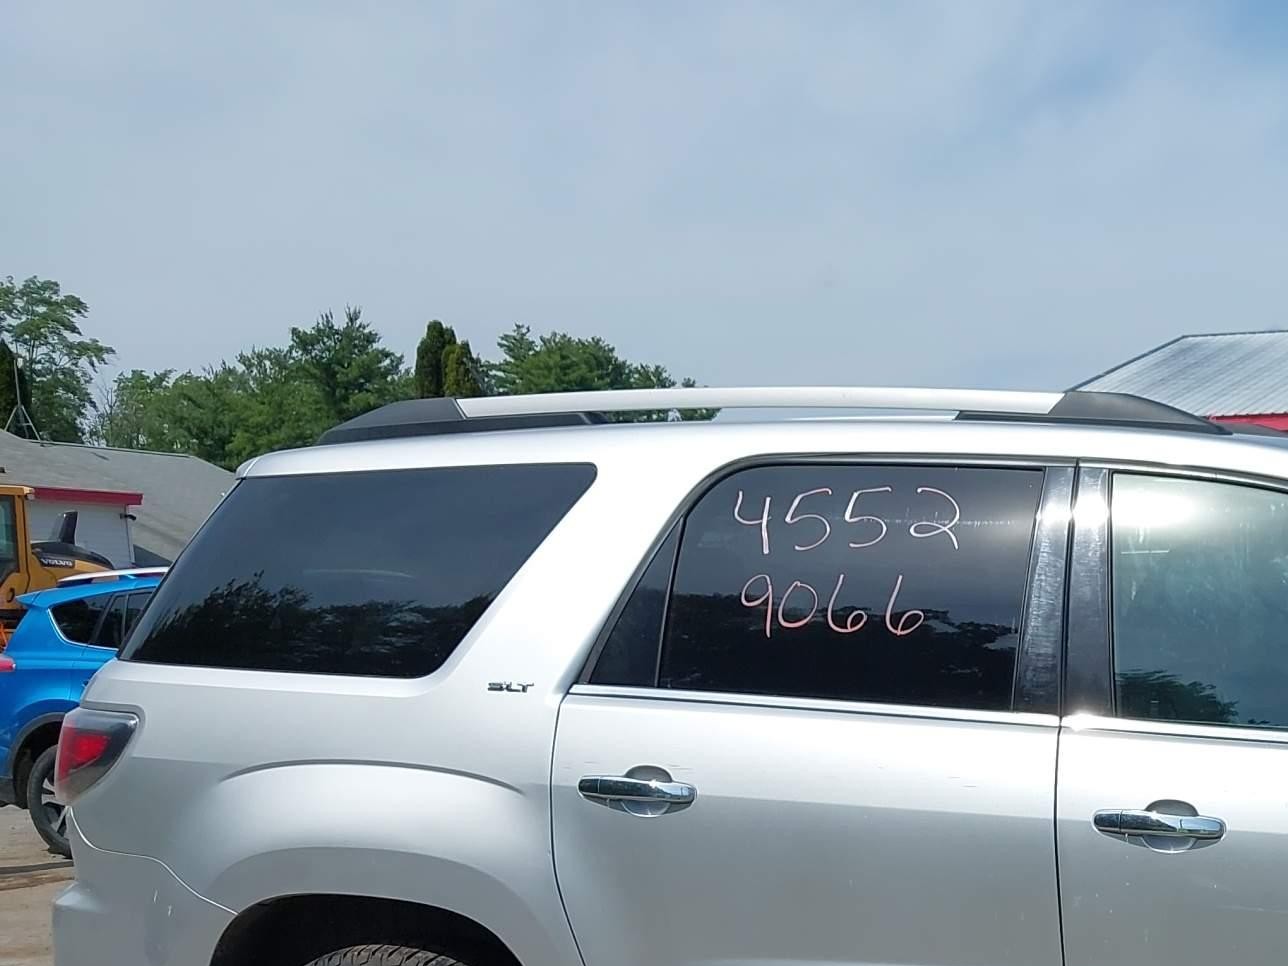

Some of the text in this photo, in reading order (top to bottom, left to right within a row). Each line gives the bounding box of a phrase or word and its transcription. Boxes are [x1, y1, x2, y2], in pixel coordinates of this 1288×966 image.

[734, 486, 960, 554] 4552
[741, 573, 925, 639] 9066
[487, 681, 535, 694] SLT
